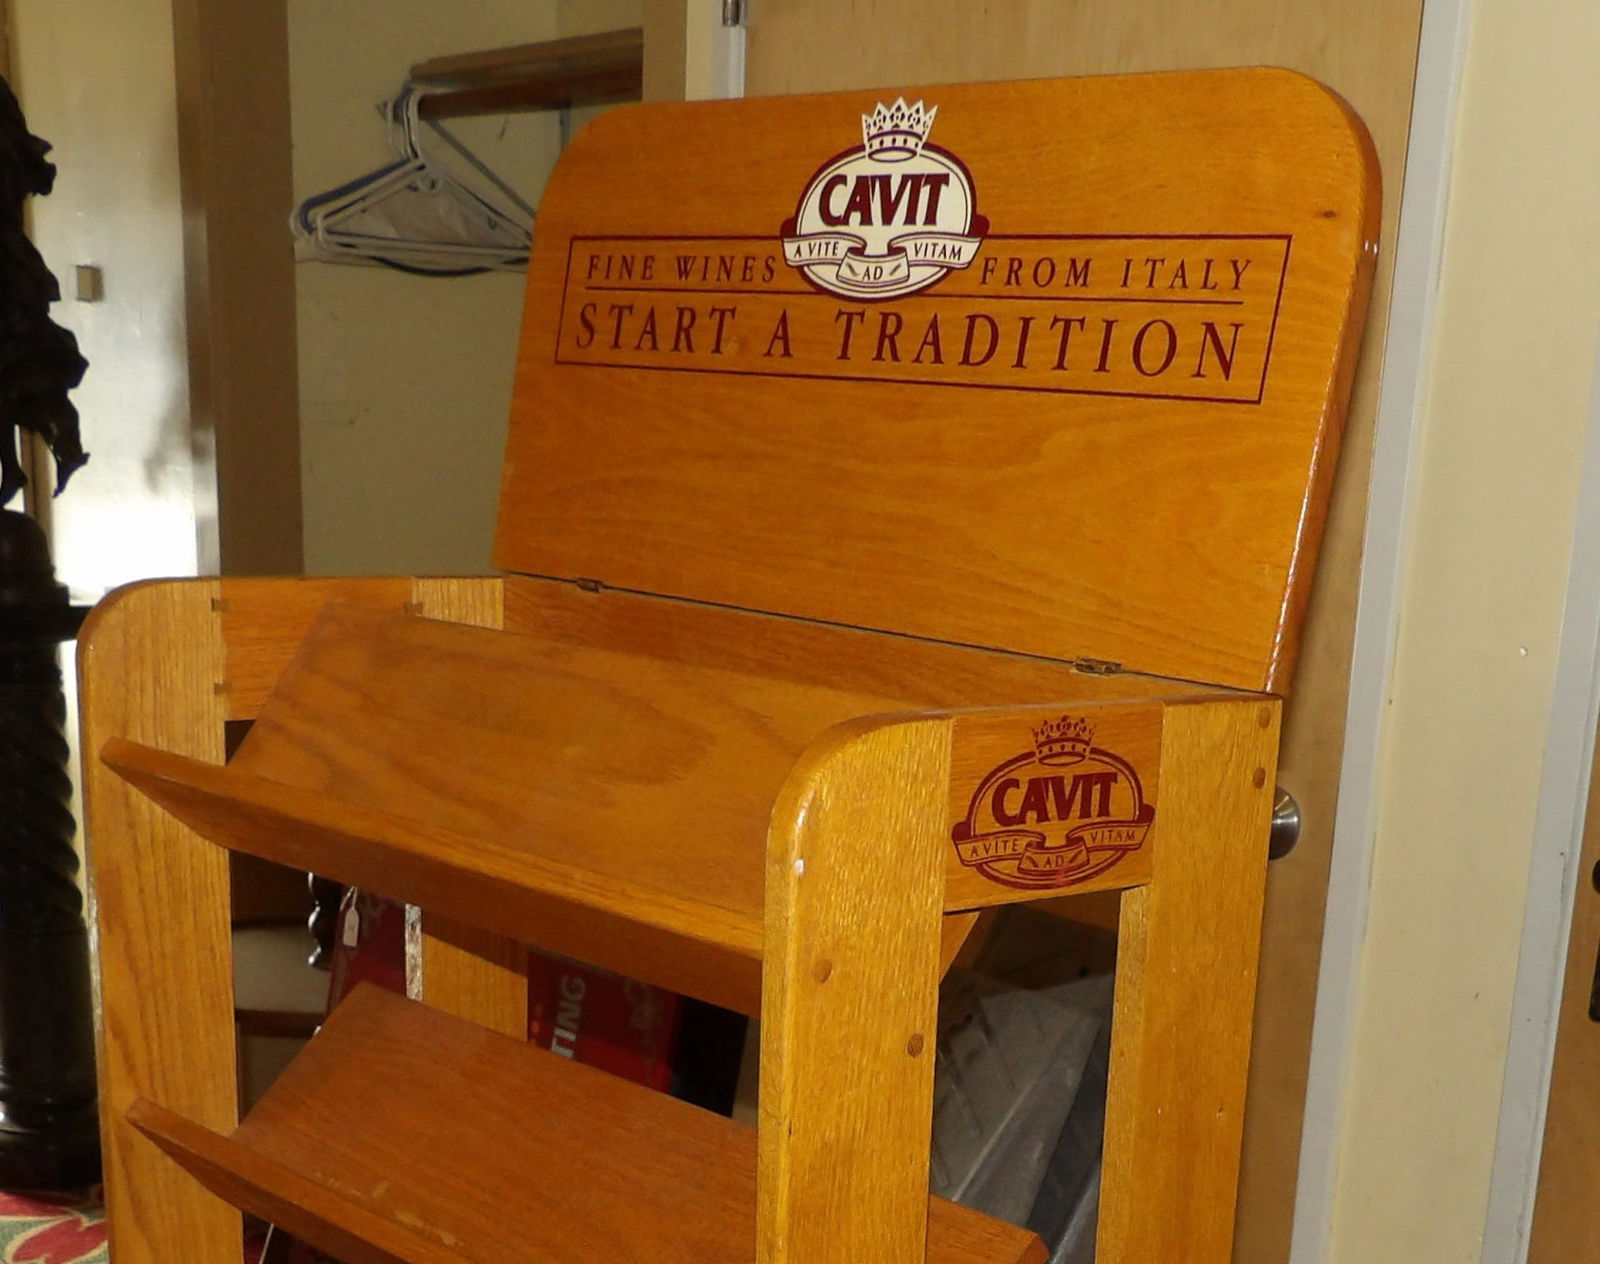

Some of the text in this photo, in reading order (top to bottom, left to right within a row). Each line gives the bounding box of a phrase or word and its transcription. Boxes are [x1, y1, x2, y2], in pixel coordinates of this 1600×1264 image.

[818, 172, 951, 227] CAVIT
[793, 240, 840, 259] A VITE
[914, 242, 962, 261] VITAM
[586, 254, 777, 284] FINE WINES
[862, 265, 884, 281] AD
[980, 256, 1253, 291] FROM ITALY
[575, 302, 1245, 381] START A TRADITION
[991, 771, 1119, 827] CAVIT
[1089, 829, 1136, 844] VITAM
[969, 838, 1019, 858] A VITE
[1043, 855, 1065, 868] AD
